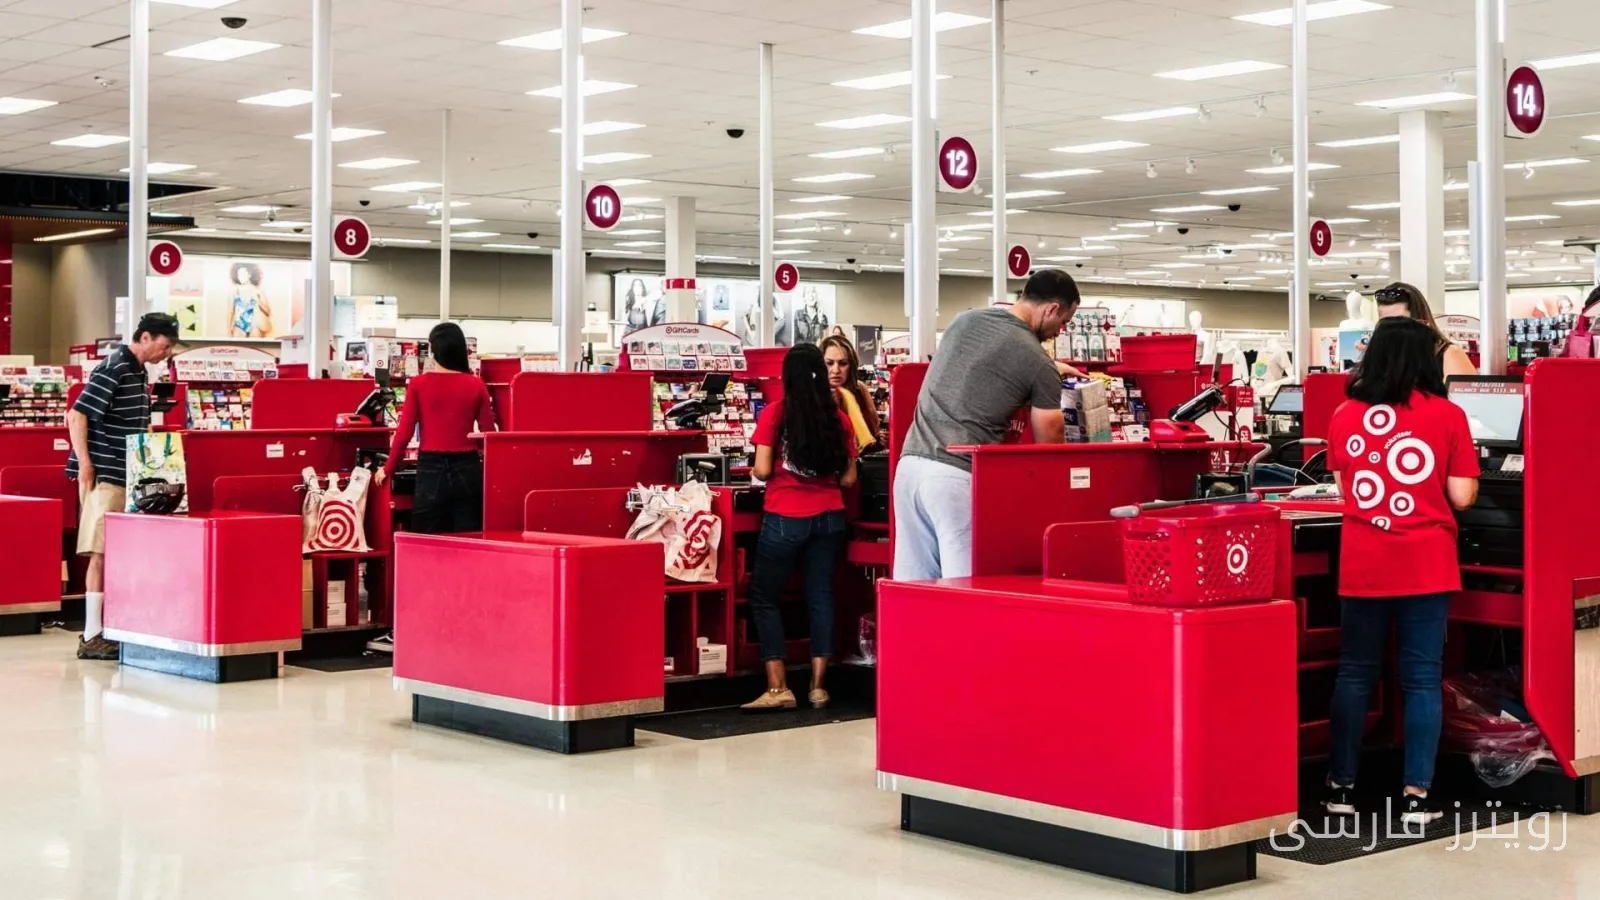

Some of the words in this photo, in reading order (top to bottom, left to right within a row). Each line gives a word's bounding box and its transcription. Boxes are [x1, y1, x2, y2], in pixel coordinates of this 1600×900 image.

[1513, 83, 1537, 117] 14
[946, 149, 968, 177] 12
[592, 195, 614, 219] 10
[345, 228, 357, 246] 8
[1316, 230, 1324, 247] 9
[160, 251, 170, 267] 6
[1015, 254, 1022, 268] 7
[782, 270, 790, 284] 5
[672, 326, 699, 334] GiftCards
[1383, 430, 1413, 449] volunteer
